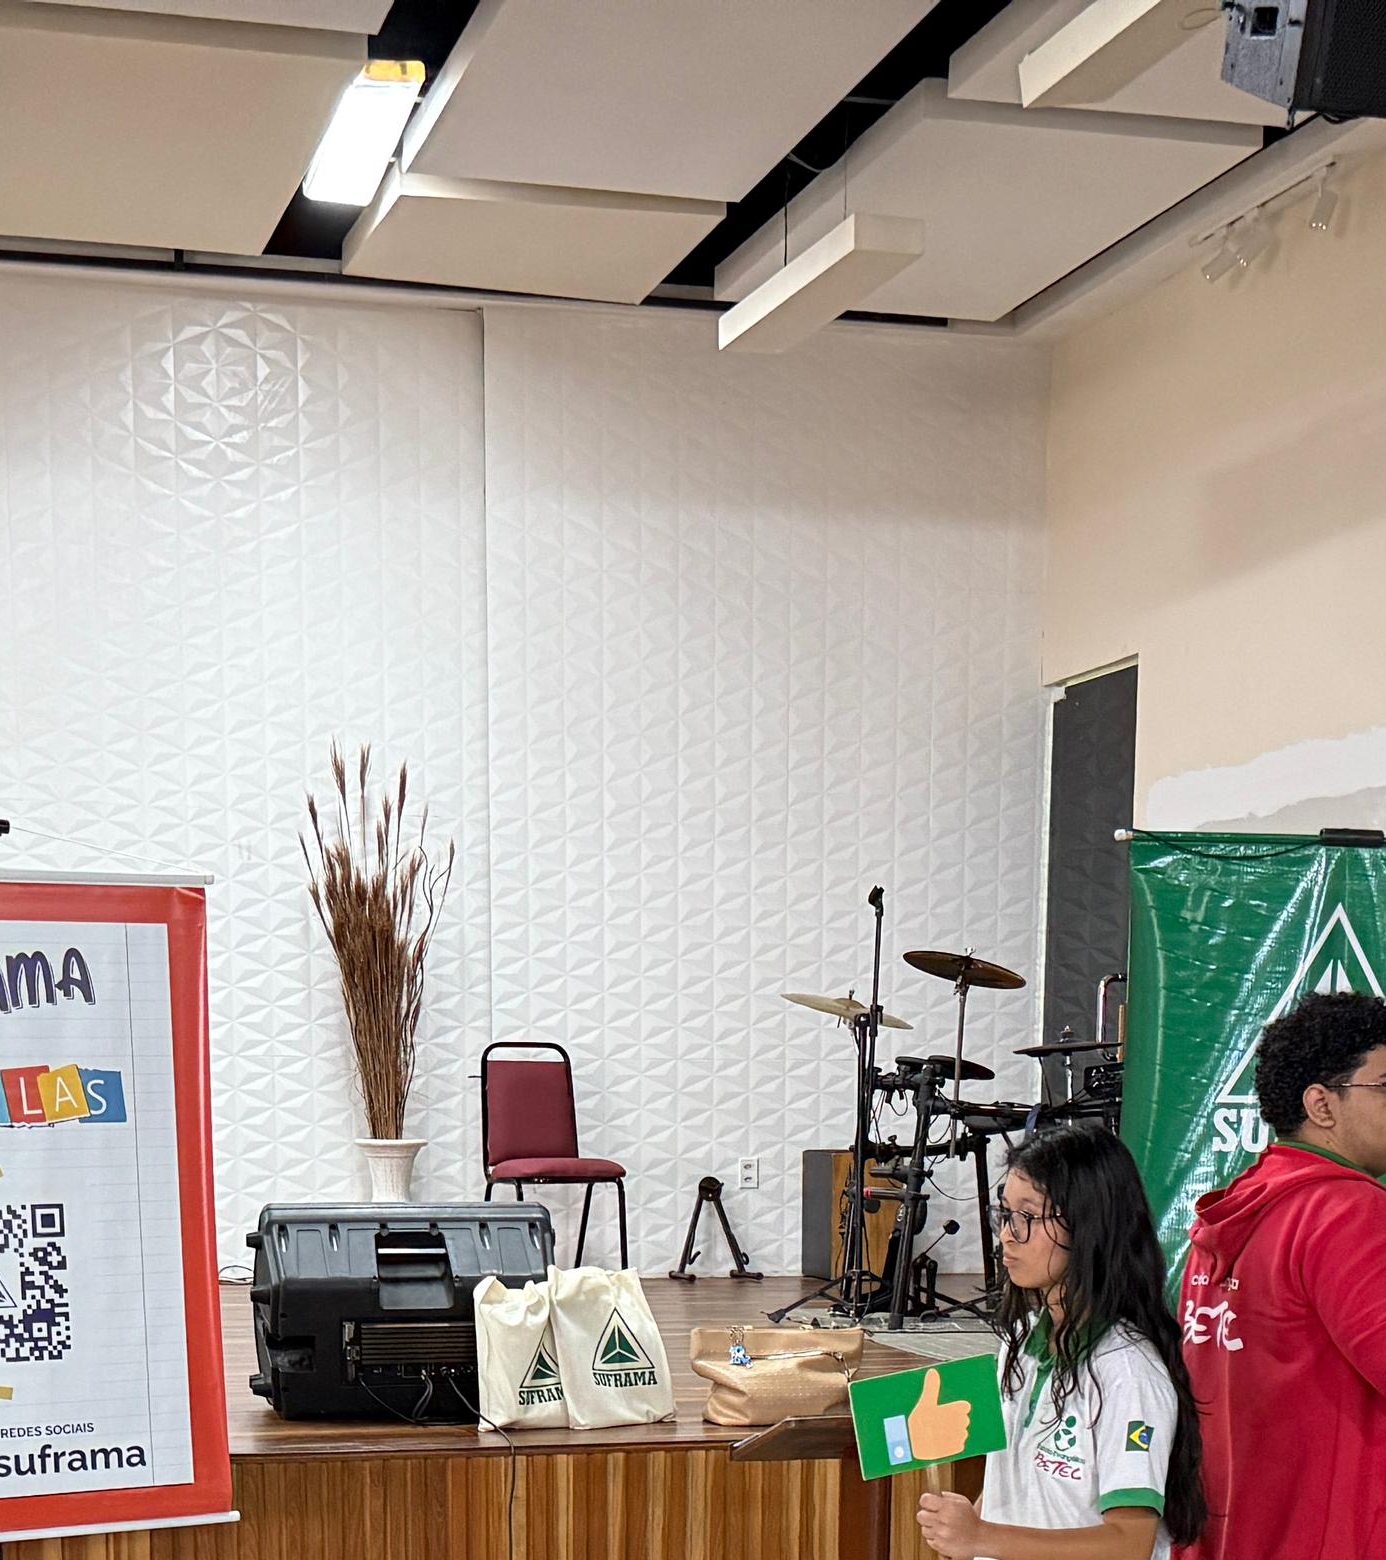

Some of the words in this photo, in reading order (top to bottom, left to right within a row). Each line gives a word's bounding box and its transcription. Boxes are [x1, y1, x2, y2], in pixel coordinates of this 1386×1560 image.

[593, 1371, 658, 1388] SUFRAMA
[0, 1426, 42, 1439] REDES
[45, 1422, 95, 1436] SOCIAIS
